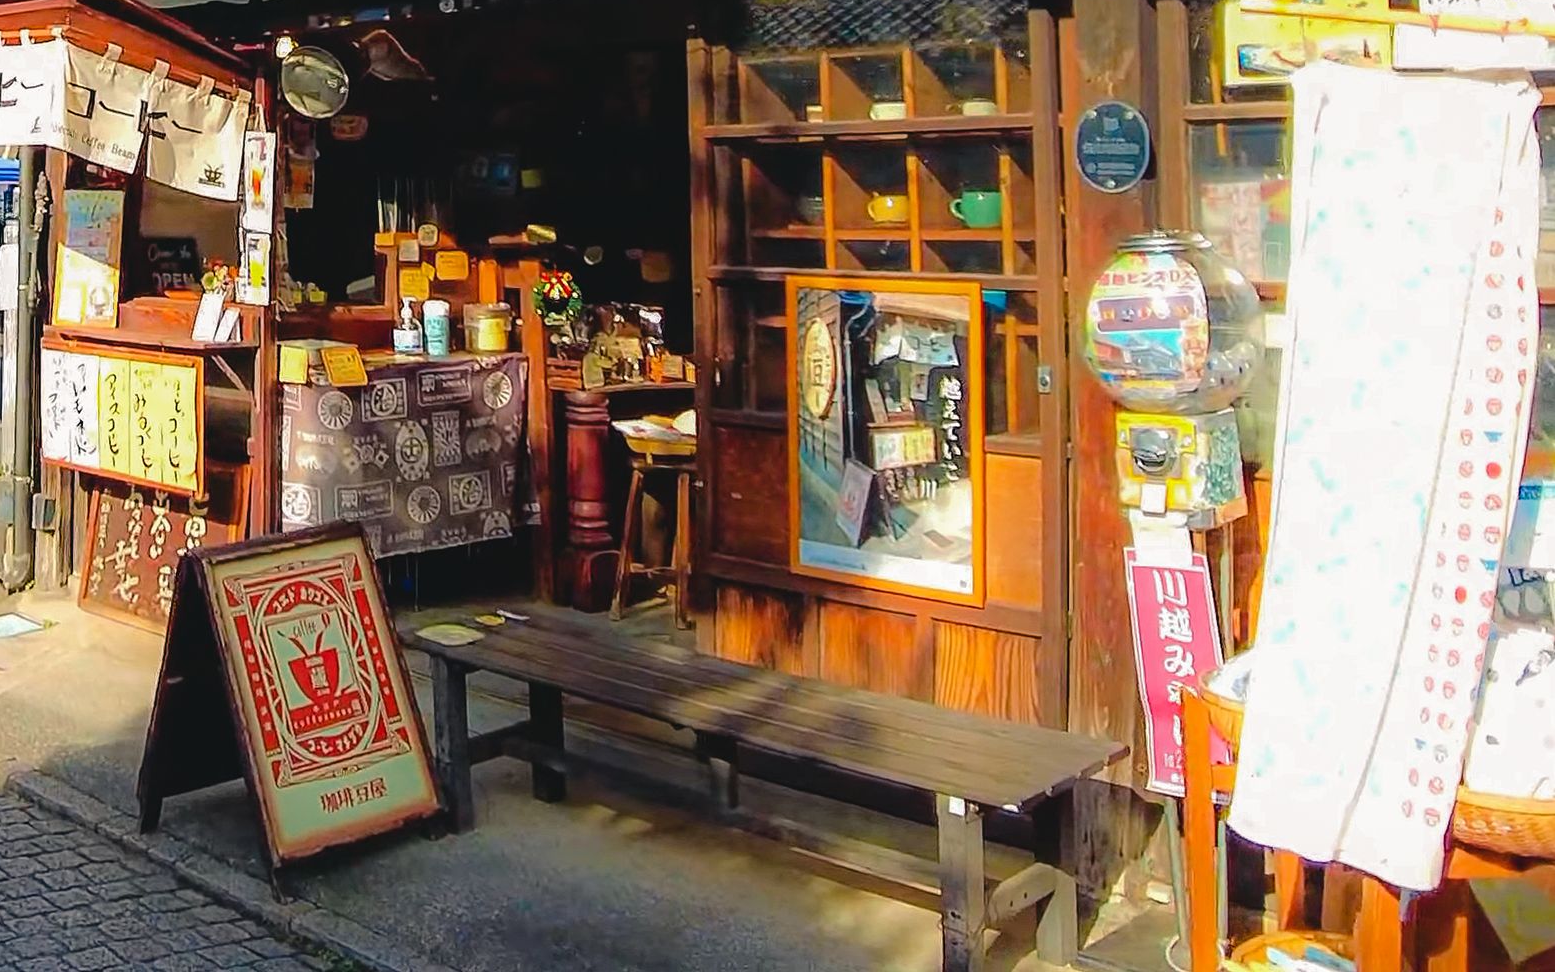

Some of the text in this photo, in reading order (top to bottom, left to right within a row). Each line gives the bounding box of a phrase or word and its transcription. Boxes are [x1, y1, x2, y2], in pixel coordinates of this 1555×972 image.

[67, 81, 203, 141] コーヒー
[320, 777, 388, 814] 珈琲豆屋
